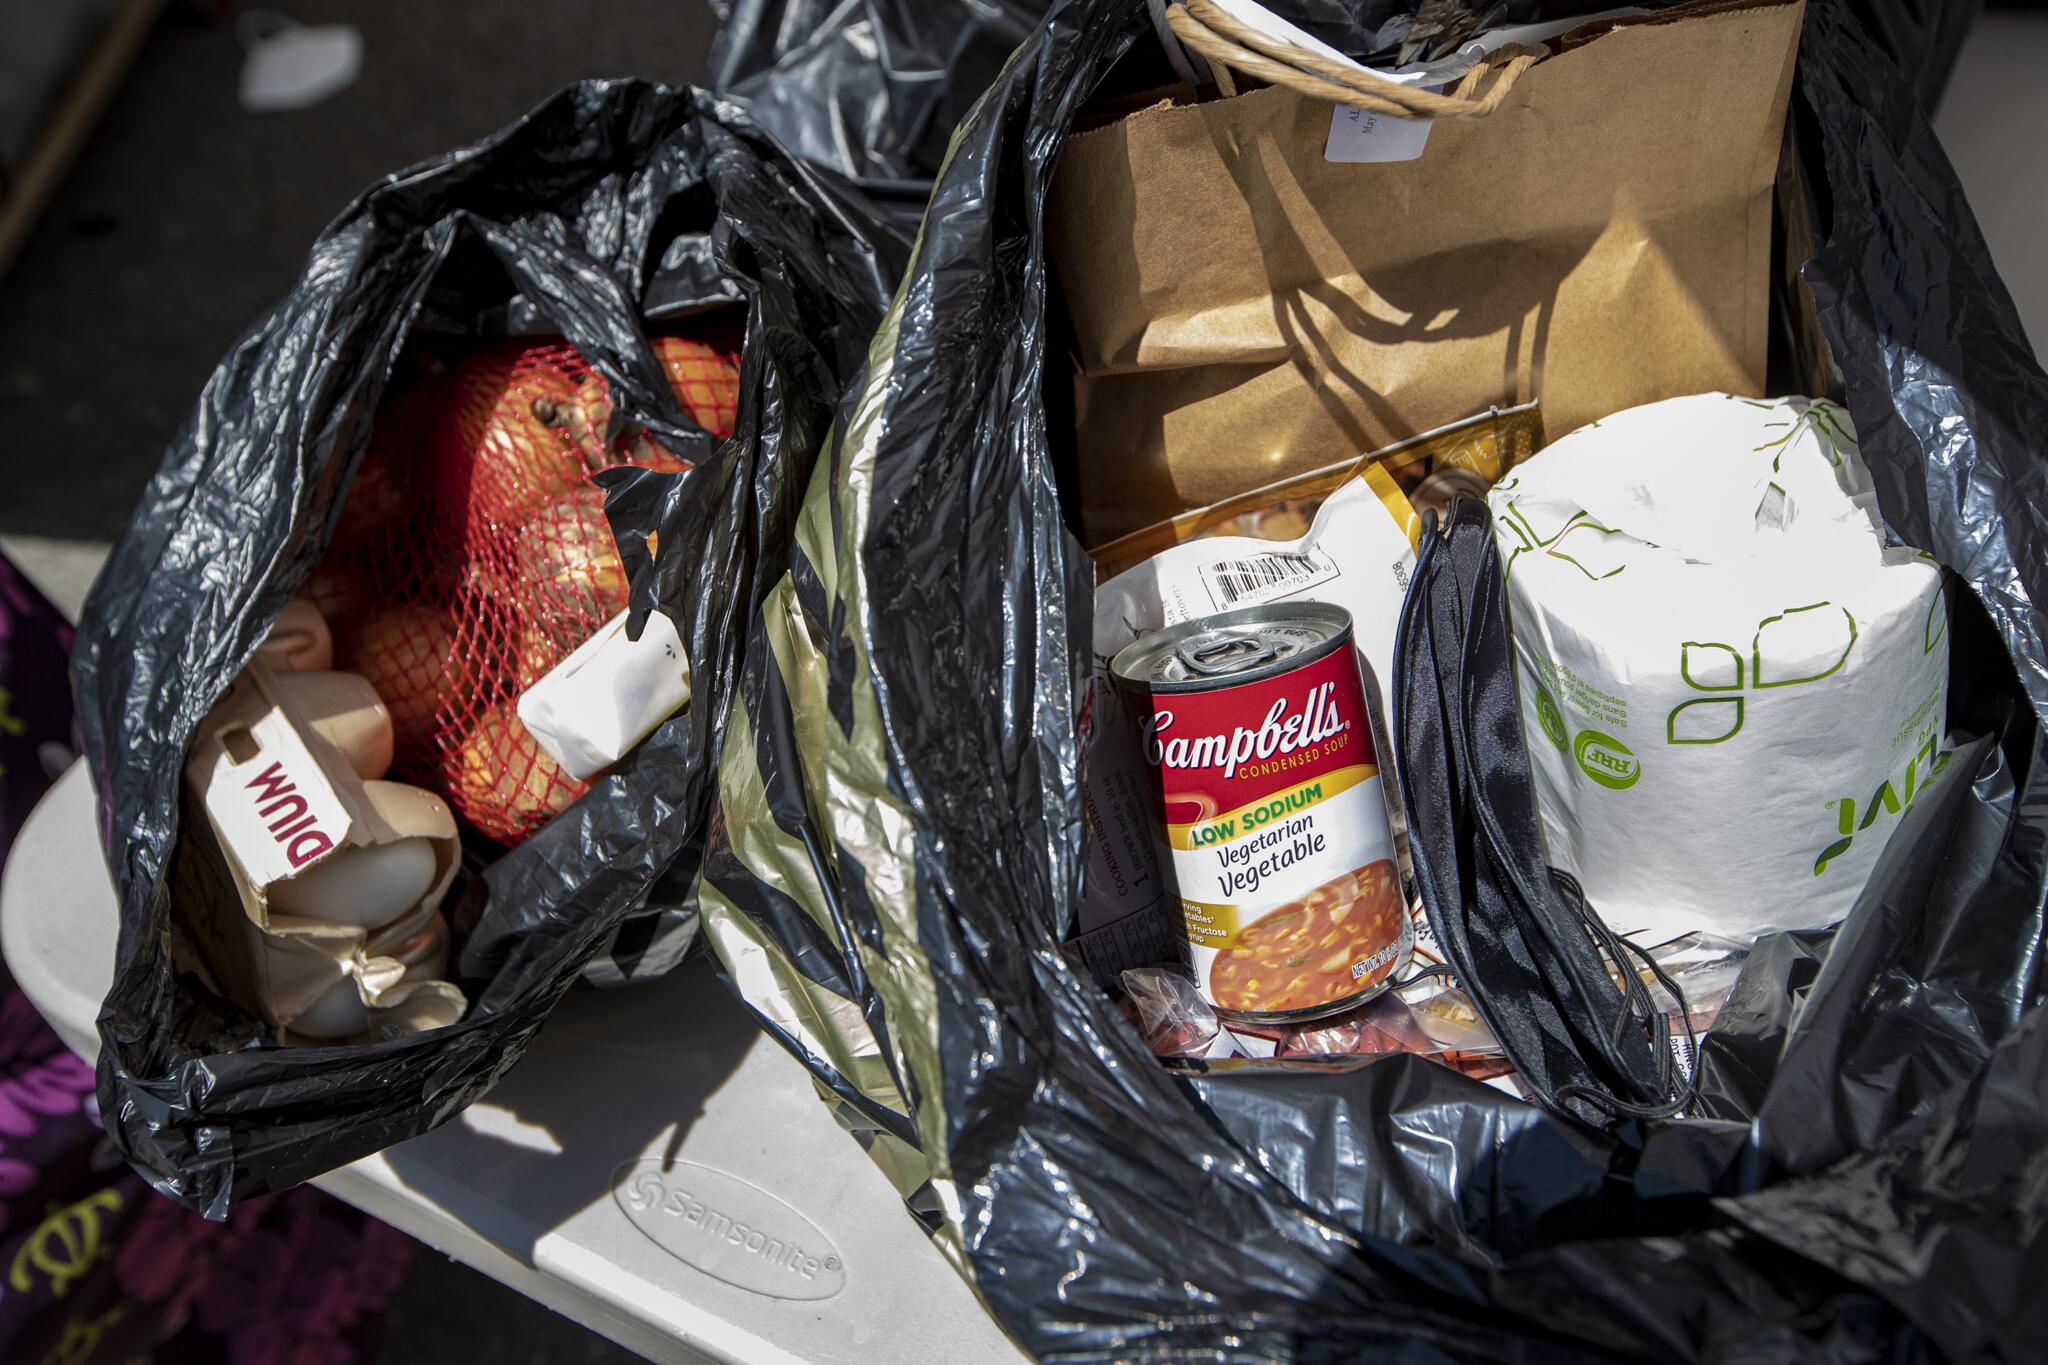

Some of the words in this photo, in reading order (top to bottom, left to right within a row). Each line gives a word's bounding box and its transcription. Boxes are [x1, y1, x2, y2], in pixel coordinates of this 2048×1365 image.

[1137, 681, 1344, 779] Campbell's
[1238, 749, 1320, 780] CONDENSED
[1323, 732, 1350, 757] SOUP
[1586, 748, 1631, 774] RRF
[245, 761, 335, 869] DIUM
[1191, 819, 1235, 847] LOW
[1241, 782, 1323, 831] SODIUM
[1216, 814, 1314, 868] Vegetarian
[1217, 833, 1326, 898] Vegetable
[664, 1188, 822, 1282] Samsonite
